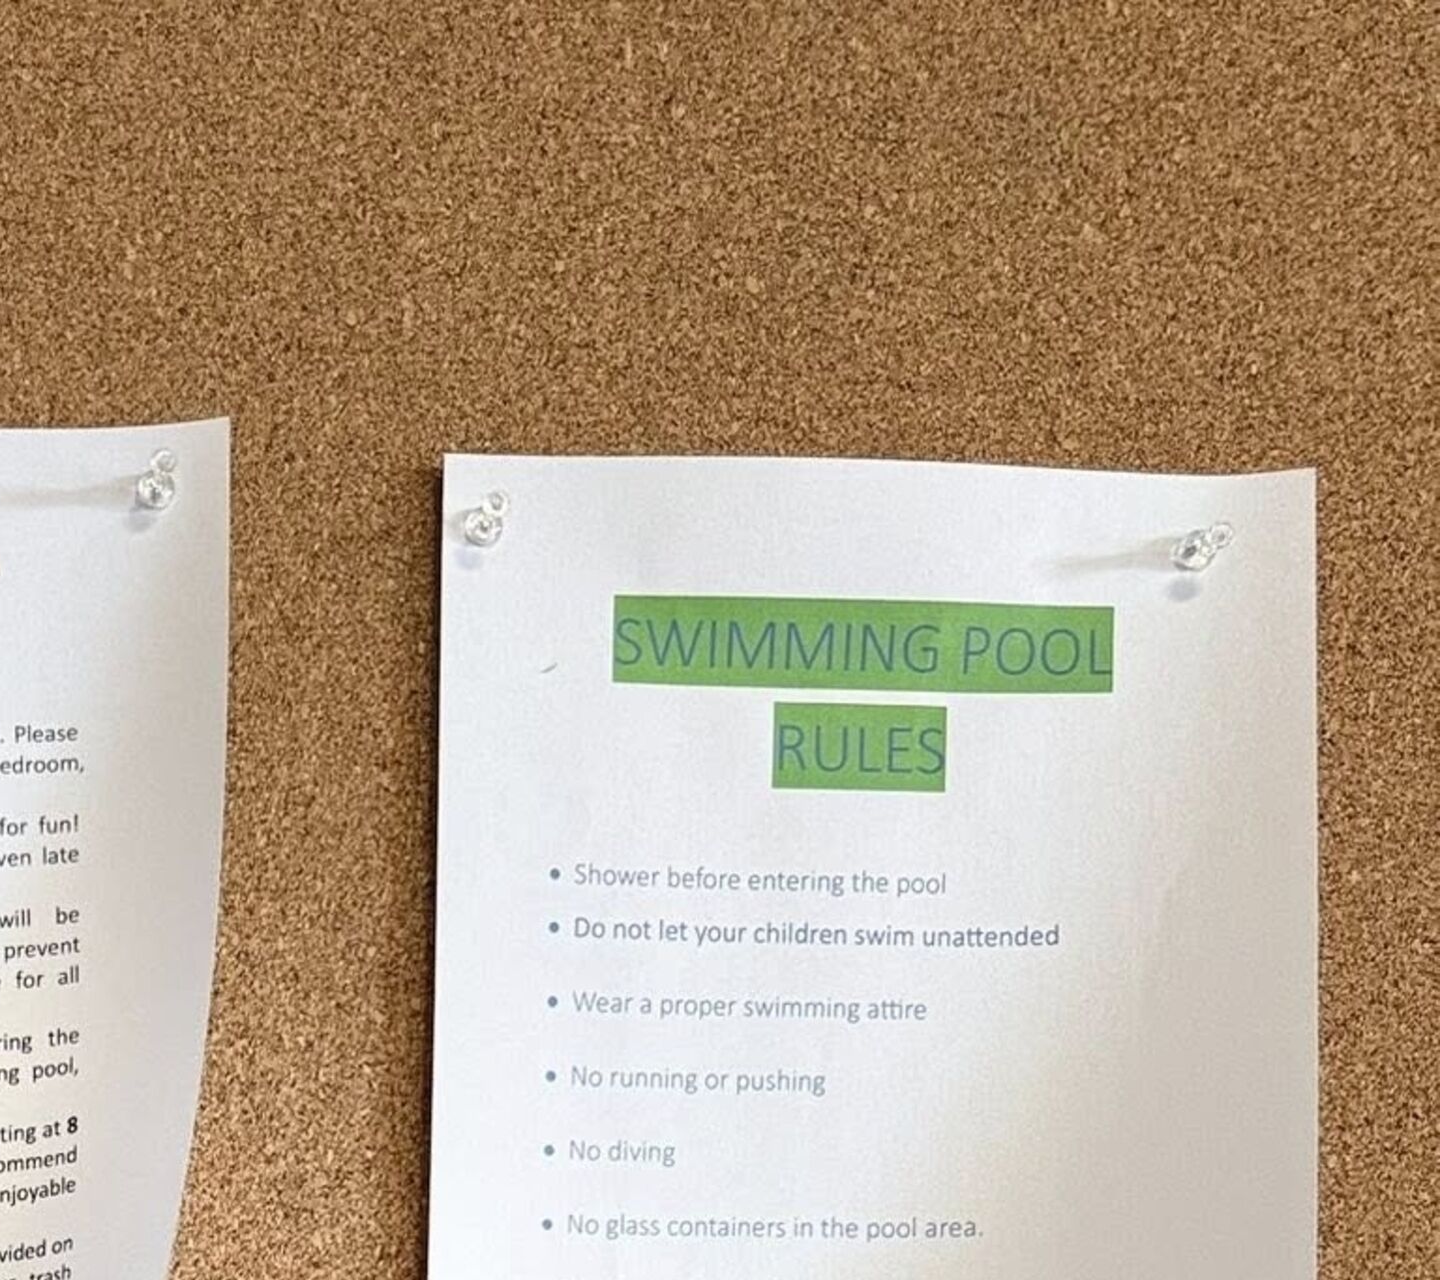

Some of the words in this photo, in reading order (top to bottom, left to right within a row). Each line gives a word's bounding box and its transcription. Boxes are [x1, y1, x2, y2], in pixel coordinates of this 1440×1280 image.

[613, 615, 941, 675] SWIMMING
[962, 624, 1113, 677] POOL
[15, 724, 78, 743] Please
[777, 722, 946, 776] RULES
[0, 817, 28, 836] for
[38, 814, 79, 835] fun!
[43, 846, 79, 865] late
[574, 862, 660, 887] Shower
[667, 865, 741, 891] before
[748, 870, 844, 898] entering
[852, 870, 889, 894] the
[896, 872, 946, 898] pool
[56, 906, 80, 925] be
[574, 917, 606, 939] Do
[613, 920, 652, 941] not
[659, 919, 688, 942] let
[694, 925, 747, 948] your
[753, 921, 847, 945] children
[854, 925, 914, 946] swim
[922, 923, 1059, 948] unattended
[4, 937, 80, 964] prevent
[572, 990, 634, 1014] Wear
[640, 997, 652, 1014] a
[660, 998, 737, 1020] proper
[743, 996, 860, 1024] swimming
[867, 999, 927, 1021] attire
[48, 1028, 80, 1047] the
[32, 1056, 79, 1084] pool,
[571, 1065, 603, 1088] No
[610, 1068, 698, 1095] running
[704, 1073, 729, 1090] or
[736, 1069, 826, 1097] pushing
[569, 1140, 601, 1161] No
[608, 1139, 675, 1168] diving
[567, 1214, 599, 1235] No
[606, 1213, 661, 1240] glass
[667, 1216, 786, 1238] containers
[793, 1217, 813, 1238] in
[820, 1216, 859, 1239] the
[866, 1216, 917, 1243] pool
[925, 1220, 983, 1238] area.
